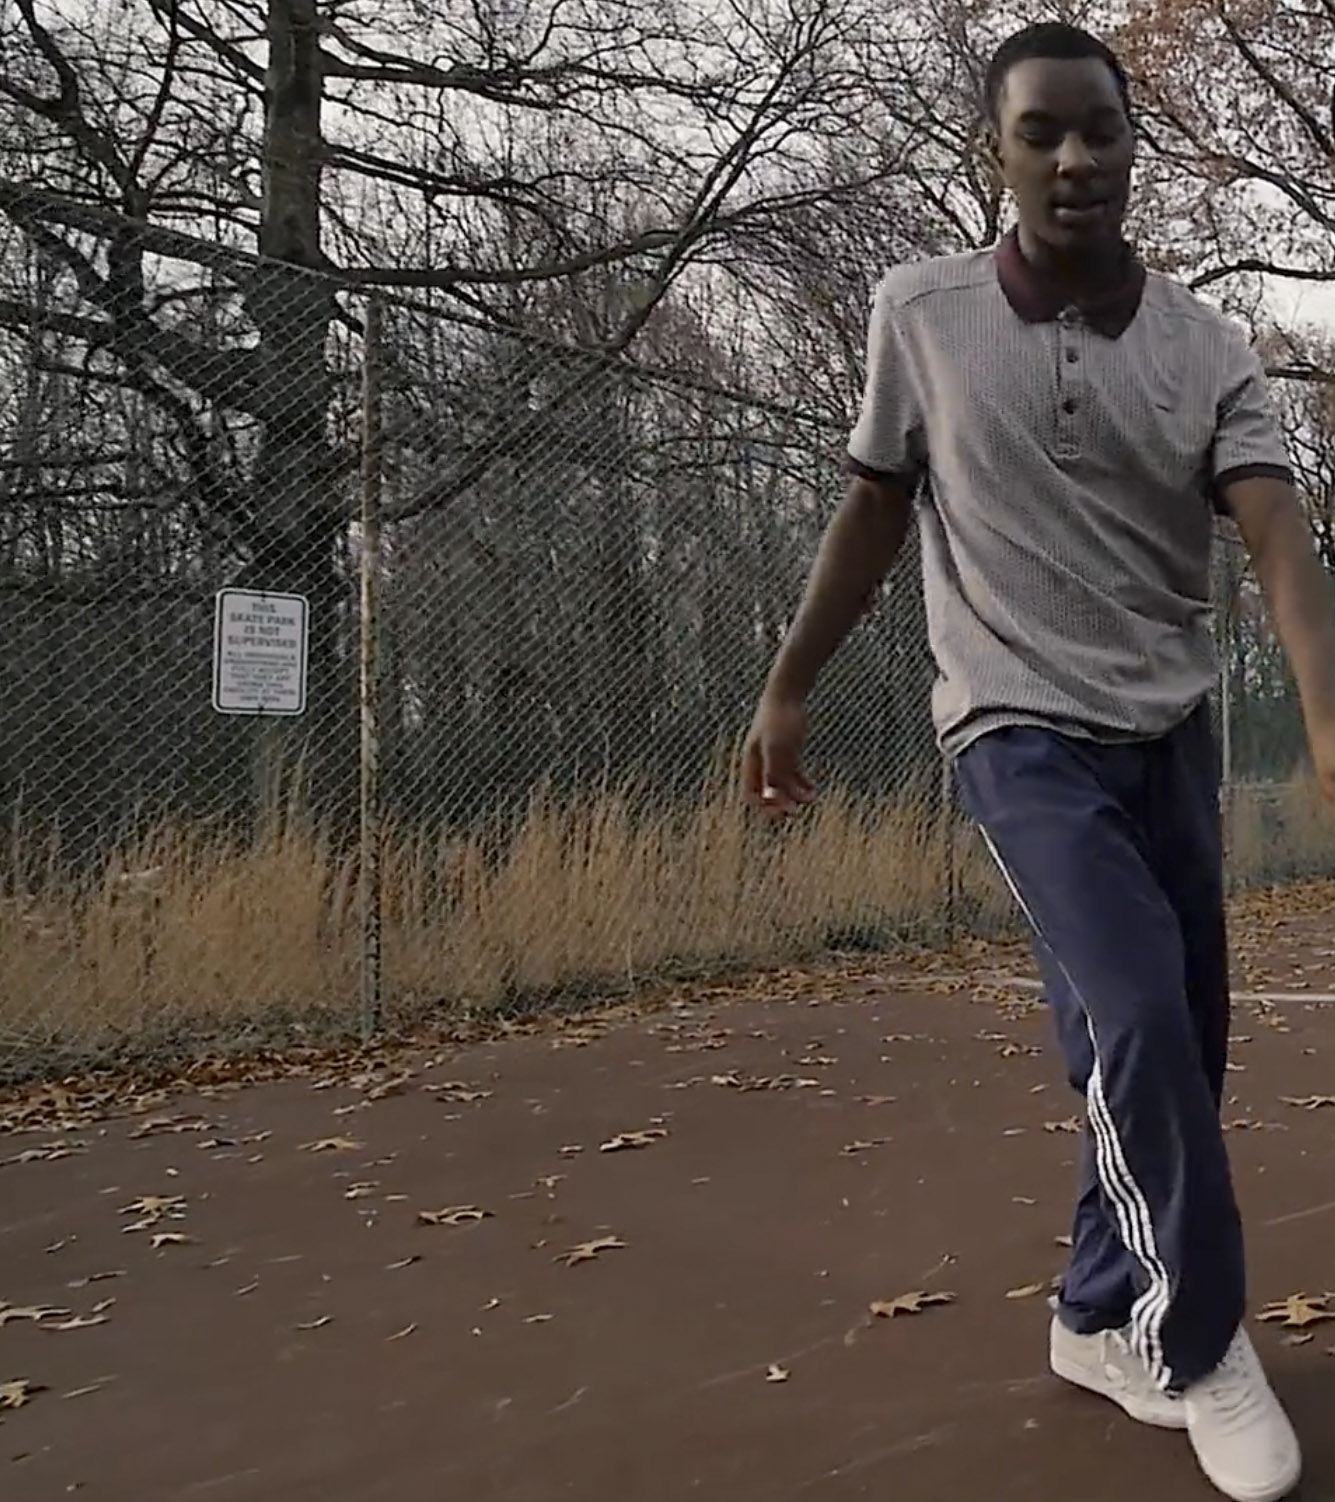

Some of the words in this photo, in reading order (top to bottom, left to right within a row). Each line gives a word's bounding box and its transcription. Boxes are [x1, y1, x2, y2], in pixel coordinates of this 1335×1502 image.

[231, 612, 263, 623] SKATE
[267, 615, 296, 626] PARK
[244, 625, 255, 634] IS
[259, 626, 279, 636] NOT
[228, 635, 297, 648] SUPERVISED
